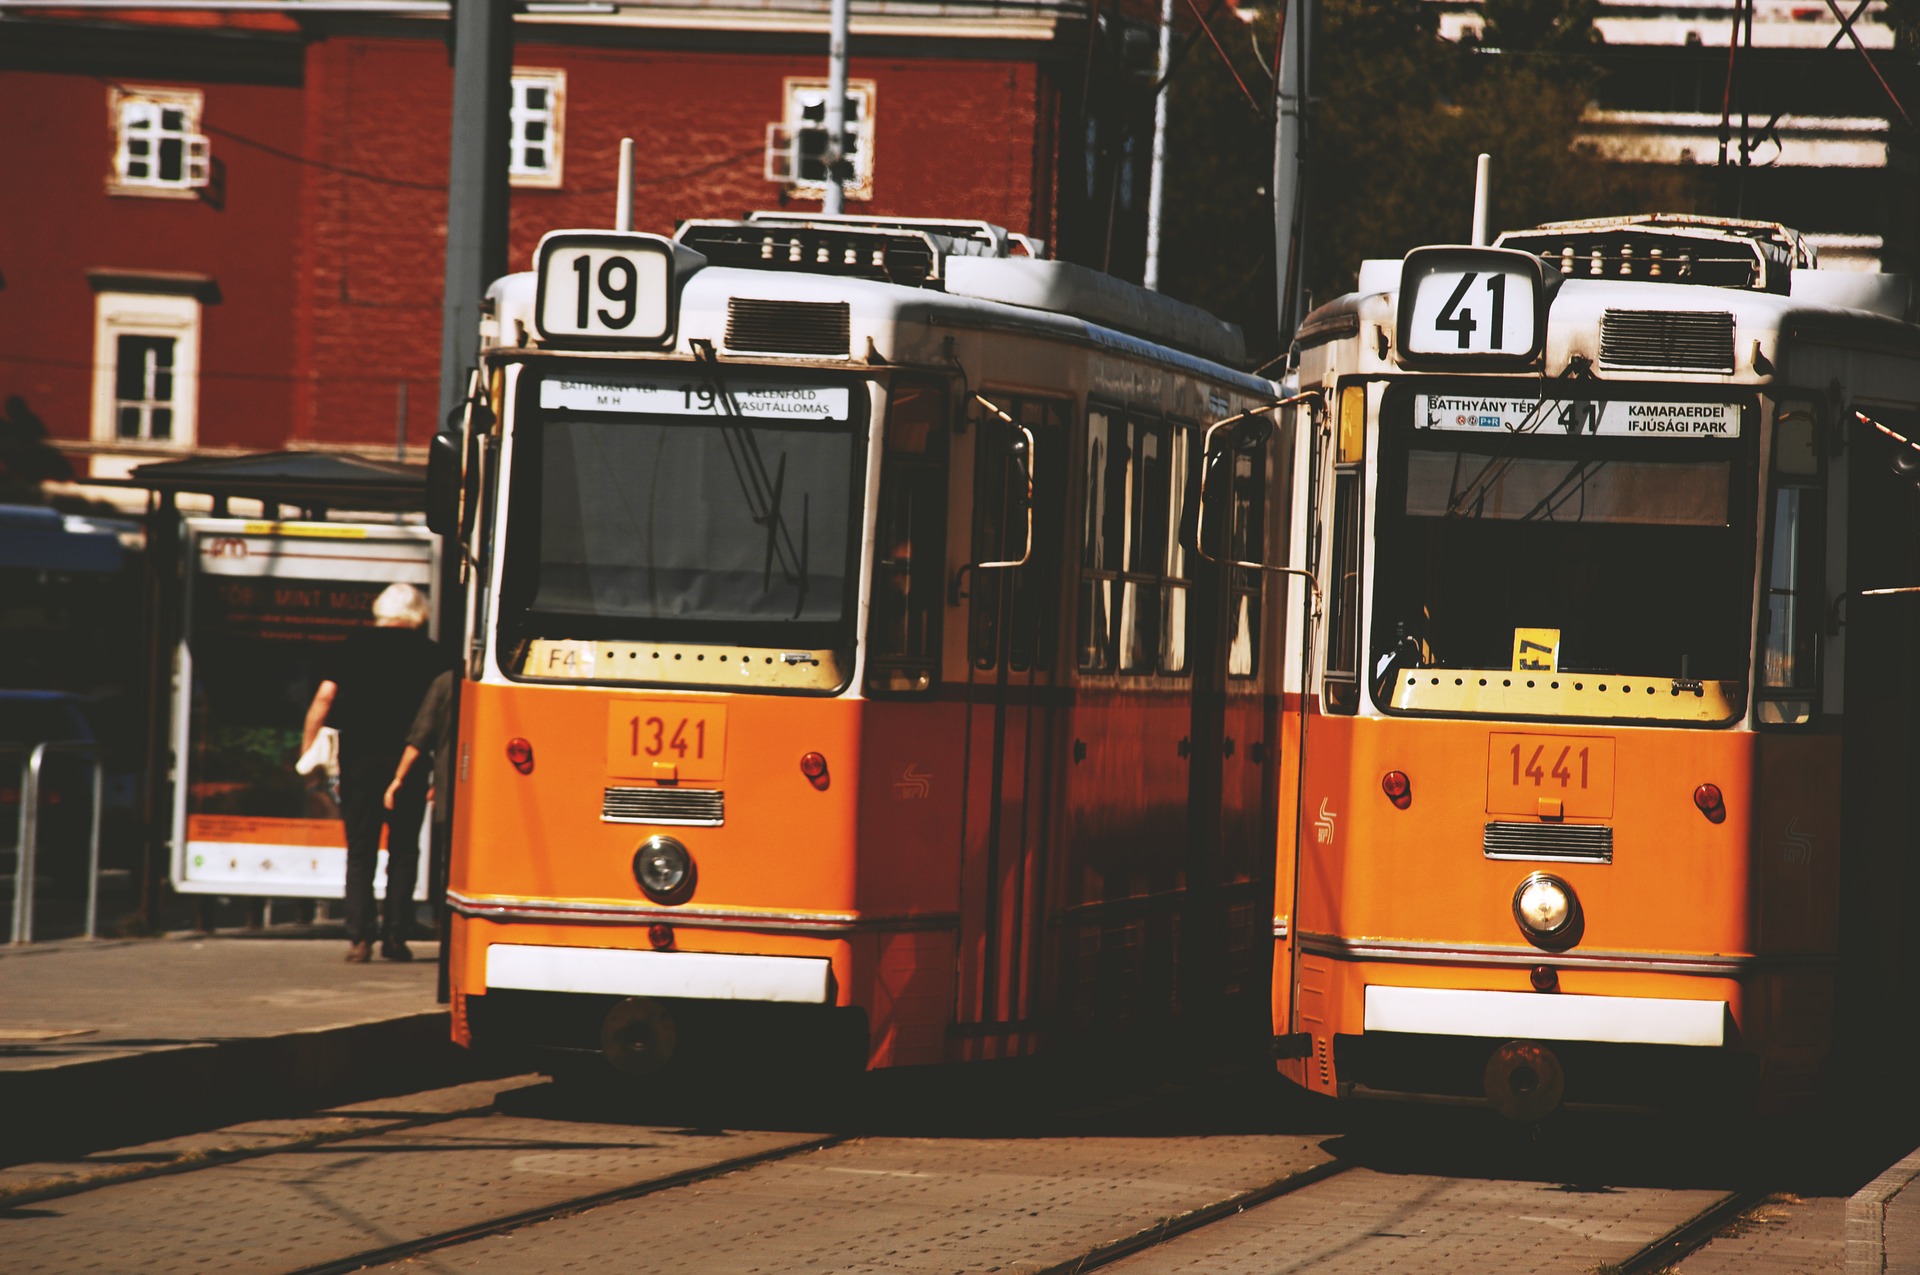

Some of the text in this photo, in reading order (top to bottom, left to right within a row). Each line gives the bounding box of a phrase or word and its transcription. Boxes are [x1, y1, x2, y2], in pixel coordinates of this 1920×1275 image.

[573, 255, 638, 330] 19
[1435, 272, 1506, 350] 41
[679, 384, 716, 410] 19
[747, 388, 816, 401] KELENFÖLD
[1429, 398, 1507, 412] BATTHYÁNY
[1480, 417, 1499, 427] P+R
[1558, 402, 1597, 432] 41
[1628, 405, 1725, 418] KAMARAERDEI
[1628, 418, 1727, 433] IFJÚSÁGI PARK
[549, 649, 577, 669] F4
[1519, 639, 1552, 671] F7
[630, 716, 705, 759] 1341
[1510, 743, 1589, 789] 1441
